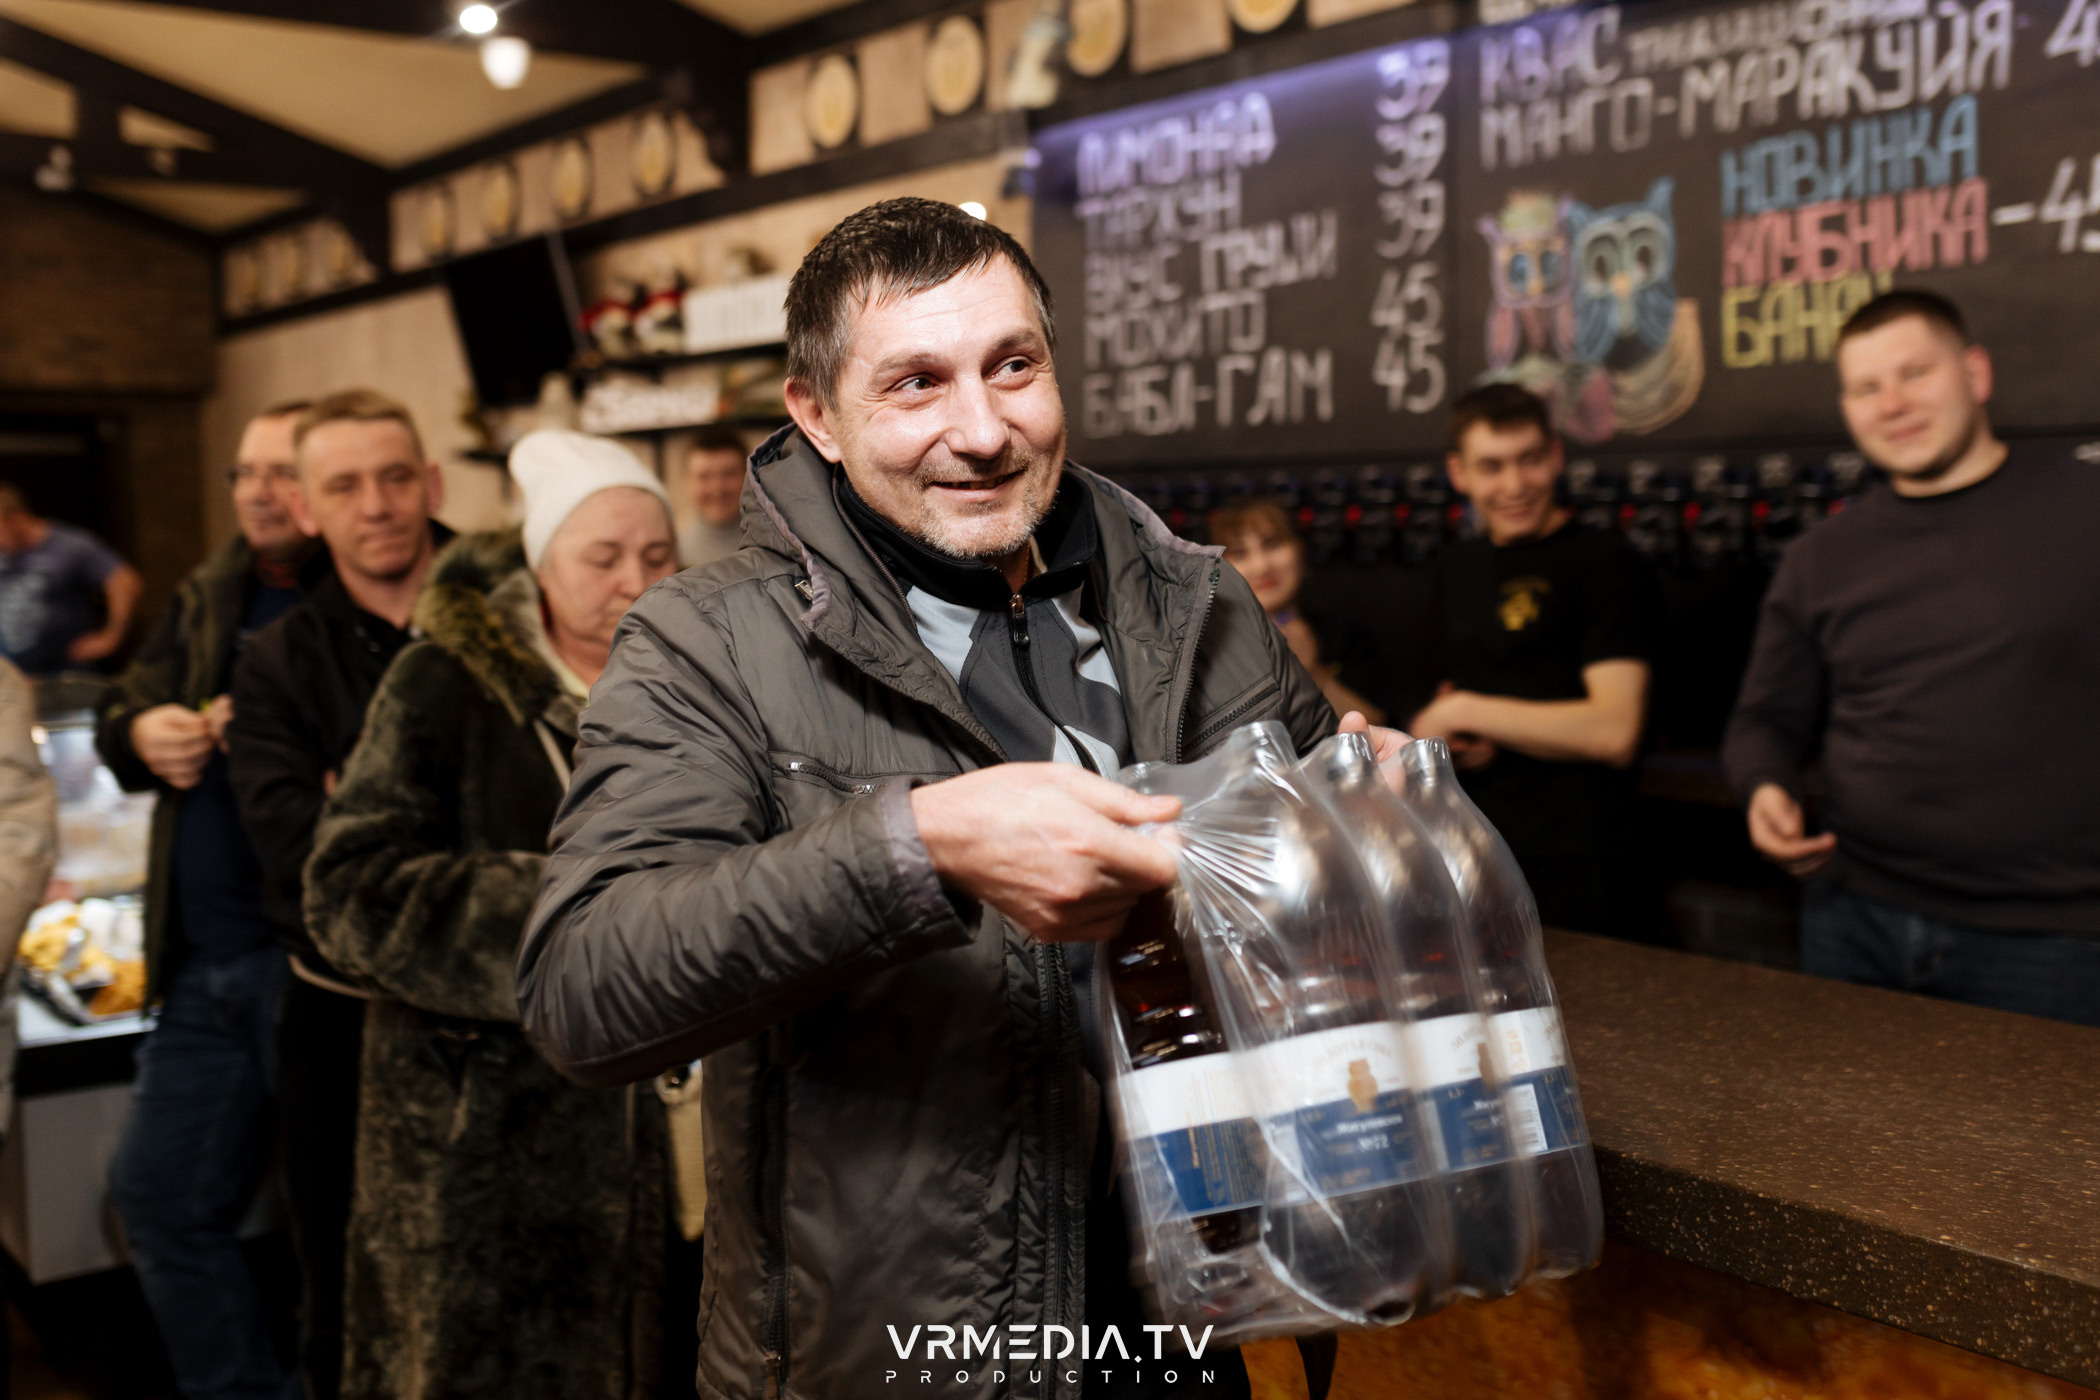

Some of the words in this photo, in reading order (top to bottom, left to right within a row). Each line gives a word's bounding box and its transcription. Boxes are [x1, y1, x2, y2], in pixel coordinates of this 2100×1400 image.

[1374, 39, 1450, 120] 39
[1479, 5, 1622, 102] КВАС
[1373, 112, 1447, 187] 39
[1720, 92, 1980, 218] НОВИНКА
[1374, 181, 1447, 259] 39
[1722, 176, 1989, 290] КЛУБНИКА
[1084, 288, 1267, 370] МОХИТО
[1370, 261, 1443, 335] 45
[1721, 268, 1894, 369] БАНА
[1371, 328, 1447, 413] 45
